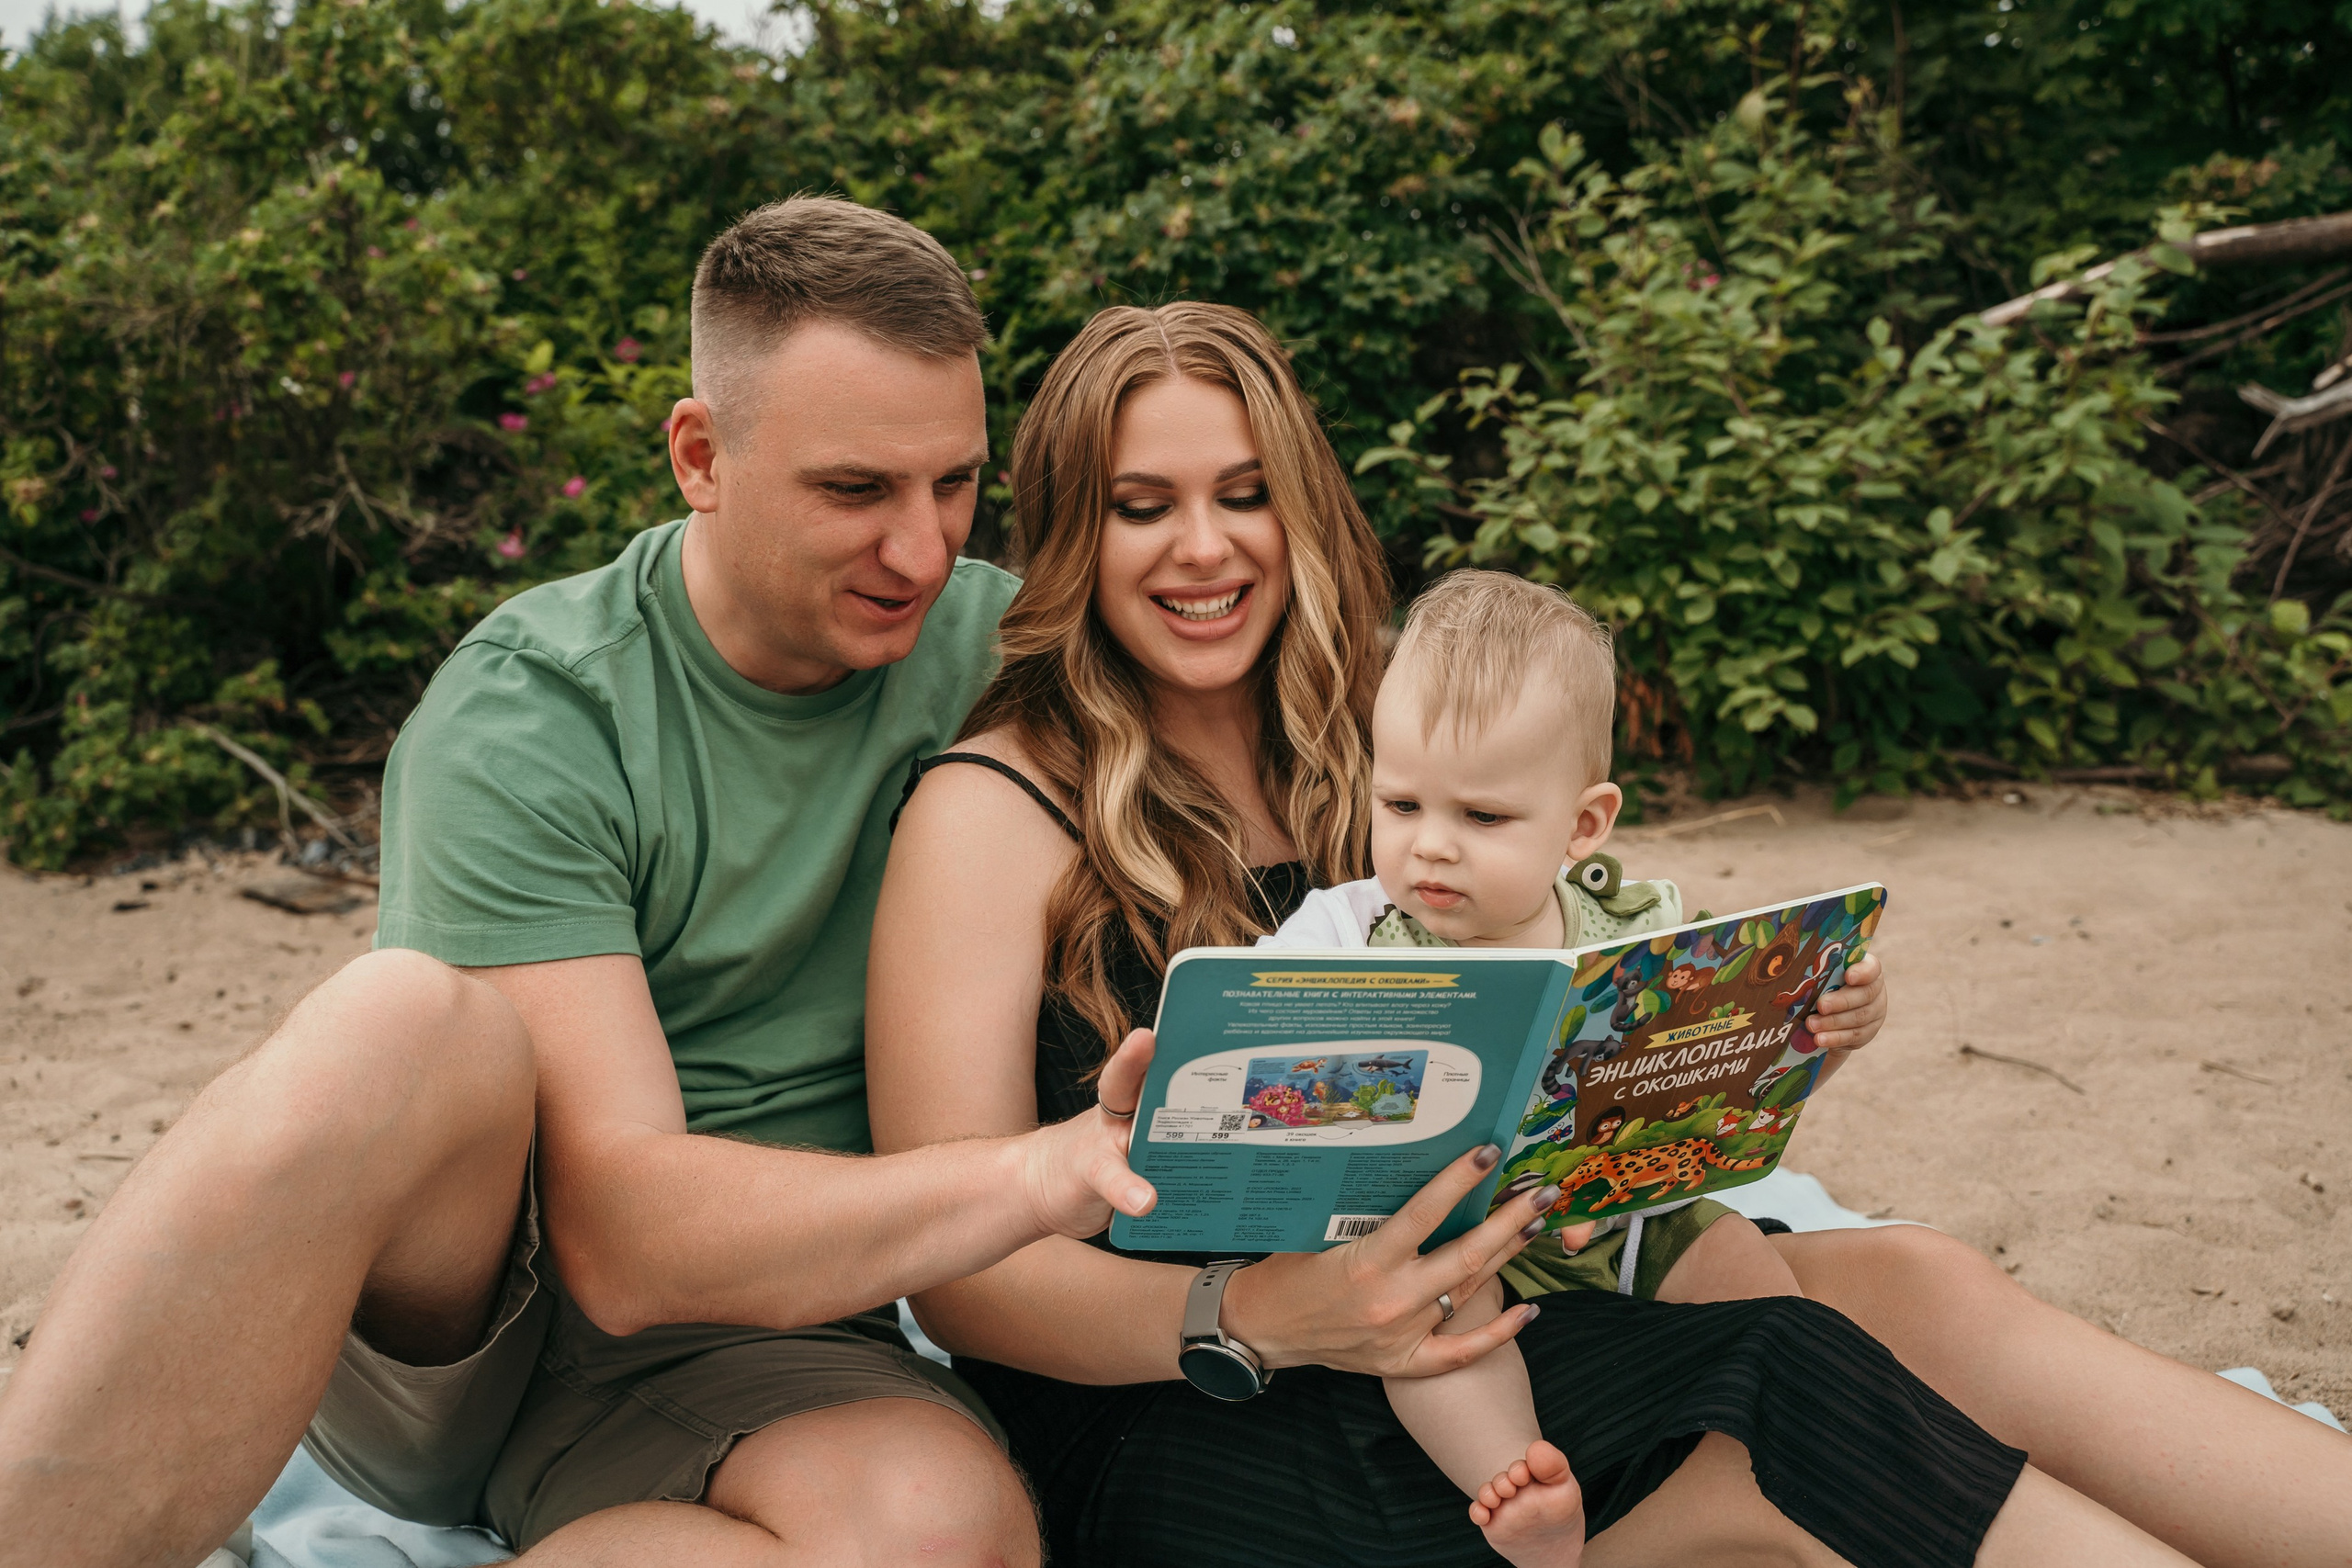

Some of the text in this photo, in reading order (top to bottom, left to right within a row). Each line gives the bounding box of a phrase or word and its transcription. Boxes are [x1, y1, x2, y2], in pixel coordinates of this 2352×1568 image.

[1295, 976, 1367, 985] «ЭНЦИКЛОПЕДИЯ
[1369, 976, 1376, 985] С
[1222, 990, 1301, 998] ПОЗНАВАТЕЛЬНЫЕ
[1303, 990, 1329, 998] КНИГИ
[1331, 990, 1339, 998] С
[1340, 991, 1418, 999] ИНТЕРАКТИВНЫМИ
[1666, 1019, 1735, 1043] ЖИВОТНЫЕ
[1585, 1022, 1793, 1087] ЭНЦИКЛОПЕДИЯ
[1632, 1057, 1751, 1098] ОКОШКАМИ
